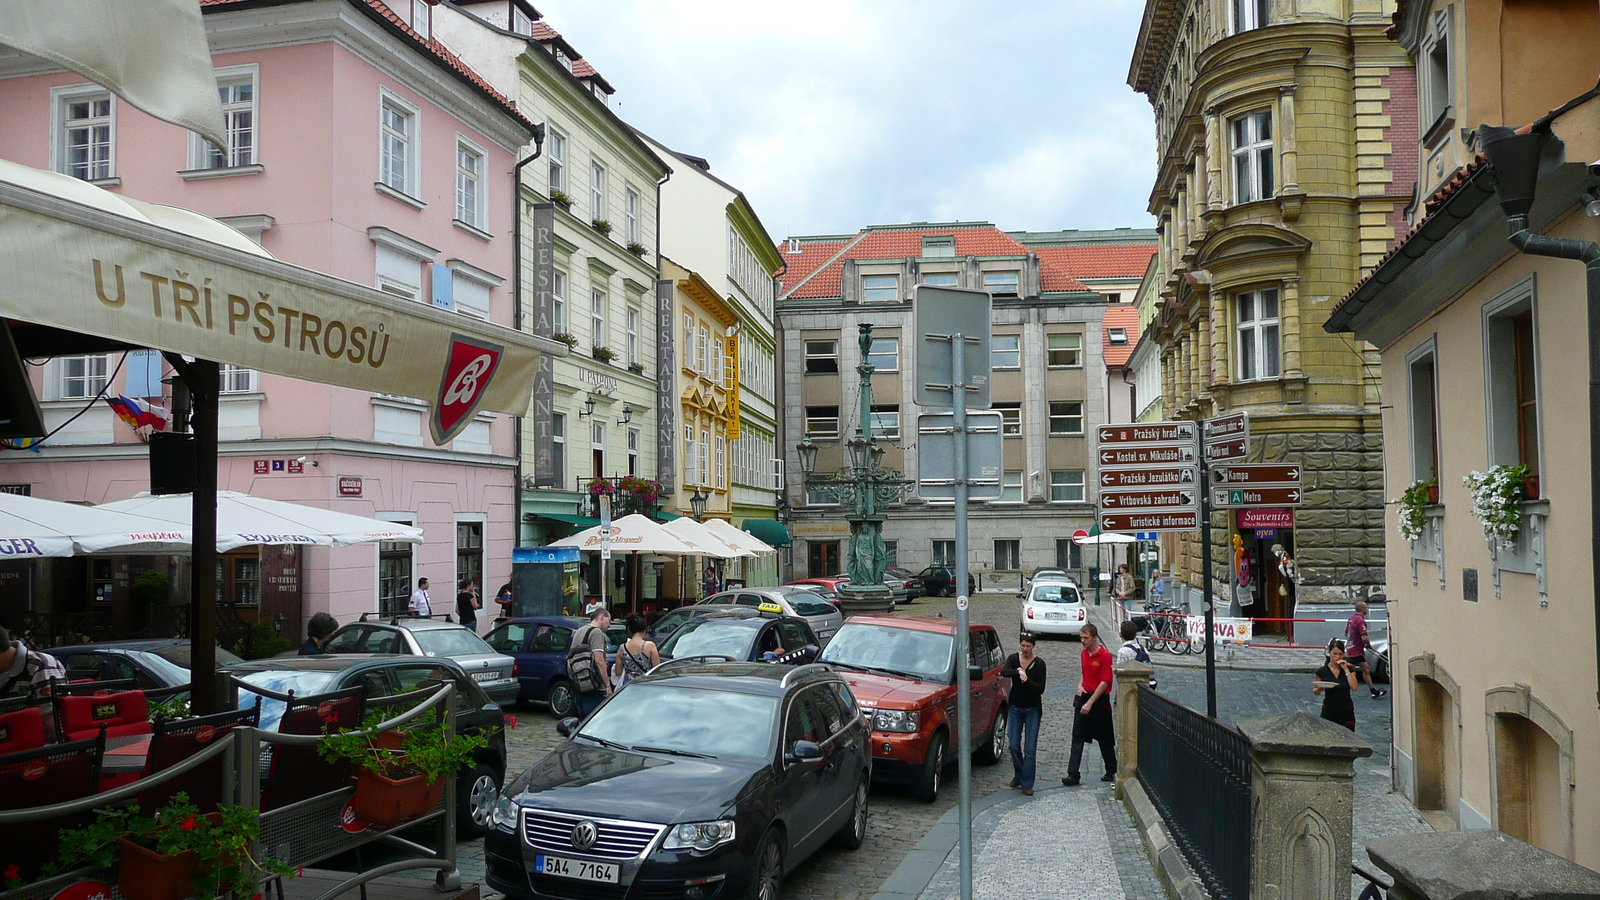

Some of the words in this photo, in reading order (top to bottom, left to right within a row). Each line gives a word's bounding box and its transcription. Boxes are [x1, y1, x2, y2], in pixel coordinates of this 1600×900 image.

[92, 258, 126, 309] U
[140, 268, 214, 330] TŘÍ
[227, 291, 390, 369] PŠTROSŮ
[536, 227, 551, 437] RESTARANT
[659, 298, 672, 459] RESTAURANT
[1134, 428, 1160, 440] Pražský
[1162, 427, 1177, 438] hrad
[1116, 451, 1137, 462] Kostel
[1150, 450, 1178, 461] Mikuláše
[1120, 472, 1146, 483] Pražské
[1148, 471, 1179, 482] Jezulátko
[1228, 470, 1249, 482] Kampa
[1119, 495, 1152, 505] Vrtbovská
[1153, 494, 1180, 504] zahrada
[1232, 492, 1240, 503] A
[1243, 492, 1262, 502] Metro
[1129, 516, 1160, 527] Turistické
[1162, 516, 1196, 526] informace
[1245, 511, 1290, 521] Souvenirs
[1256, 529, 1274, 538] open
[1189, 619, 1235, 638] VÝSAVA
[546, 859, 569, 875] 5A4
[579, 863, 612, 880] 7164
